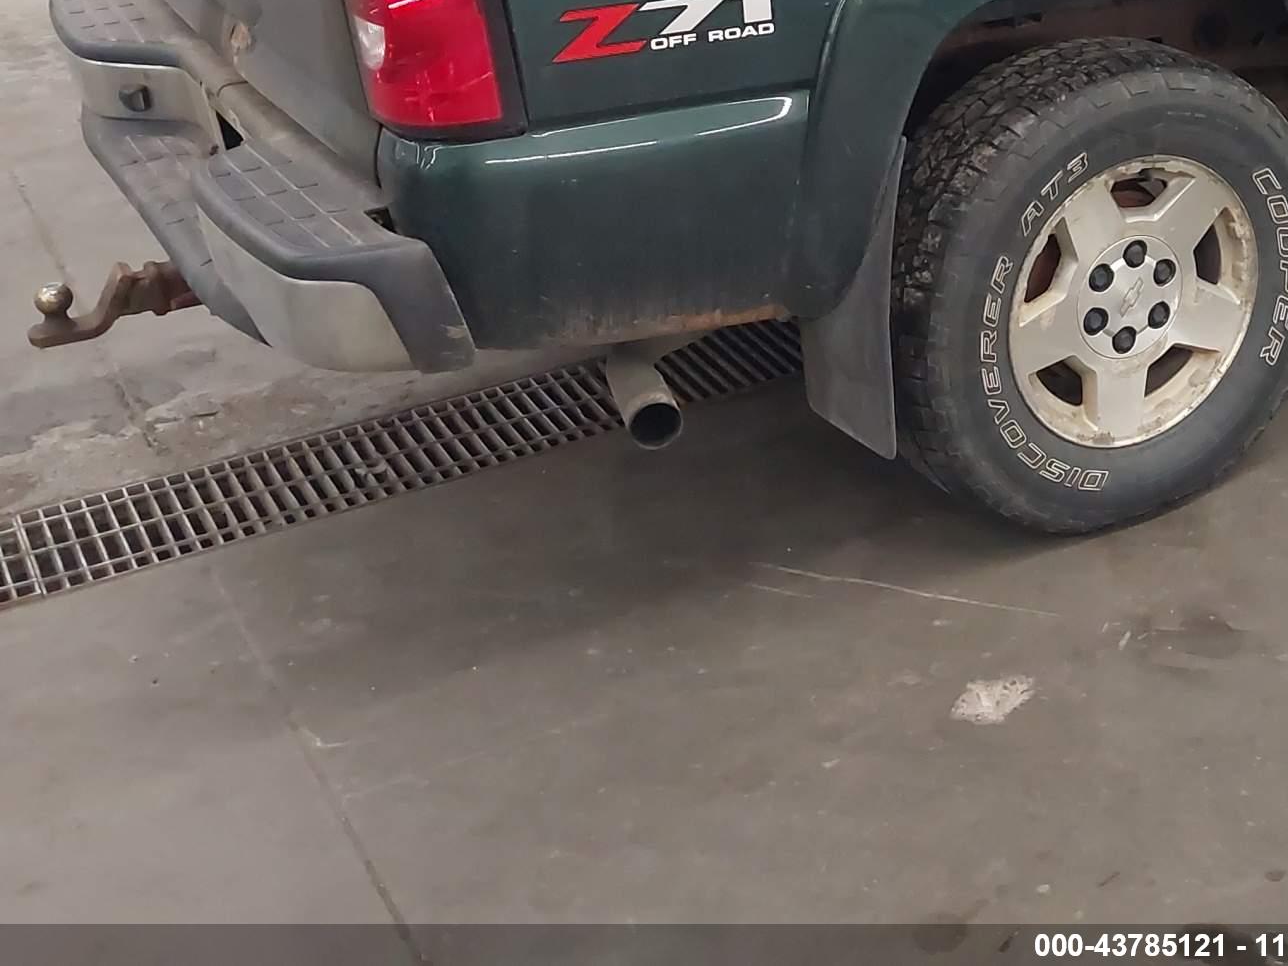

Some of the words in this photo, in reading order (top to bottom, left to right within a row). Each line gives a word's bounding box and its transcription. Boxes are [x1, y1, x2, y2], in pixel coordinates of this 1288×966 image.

[650, 33, 698, 51] OFF
[708, 22, 775, 43] ROAD
[1020, 151, 1089, 237] AT3
[979, 255, 1110, 492] DISCOVERER
